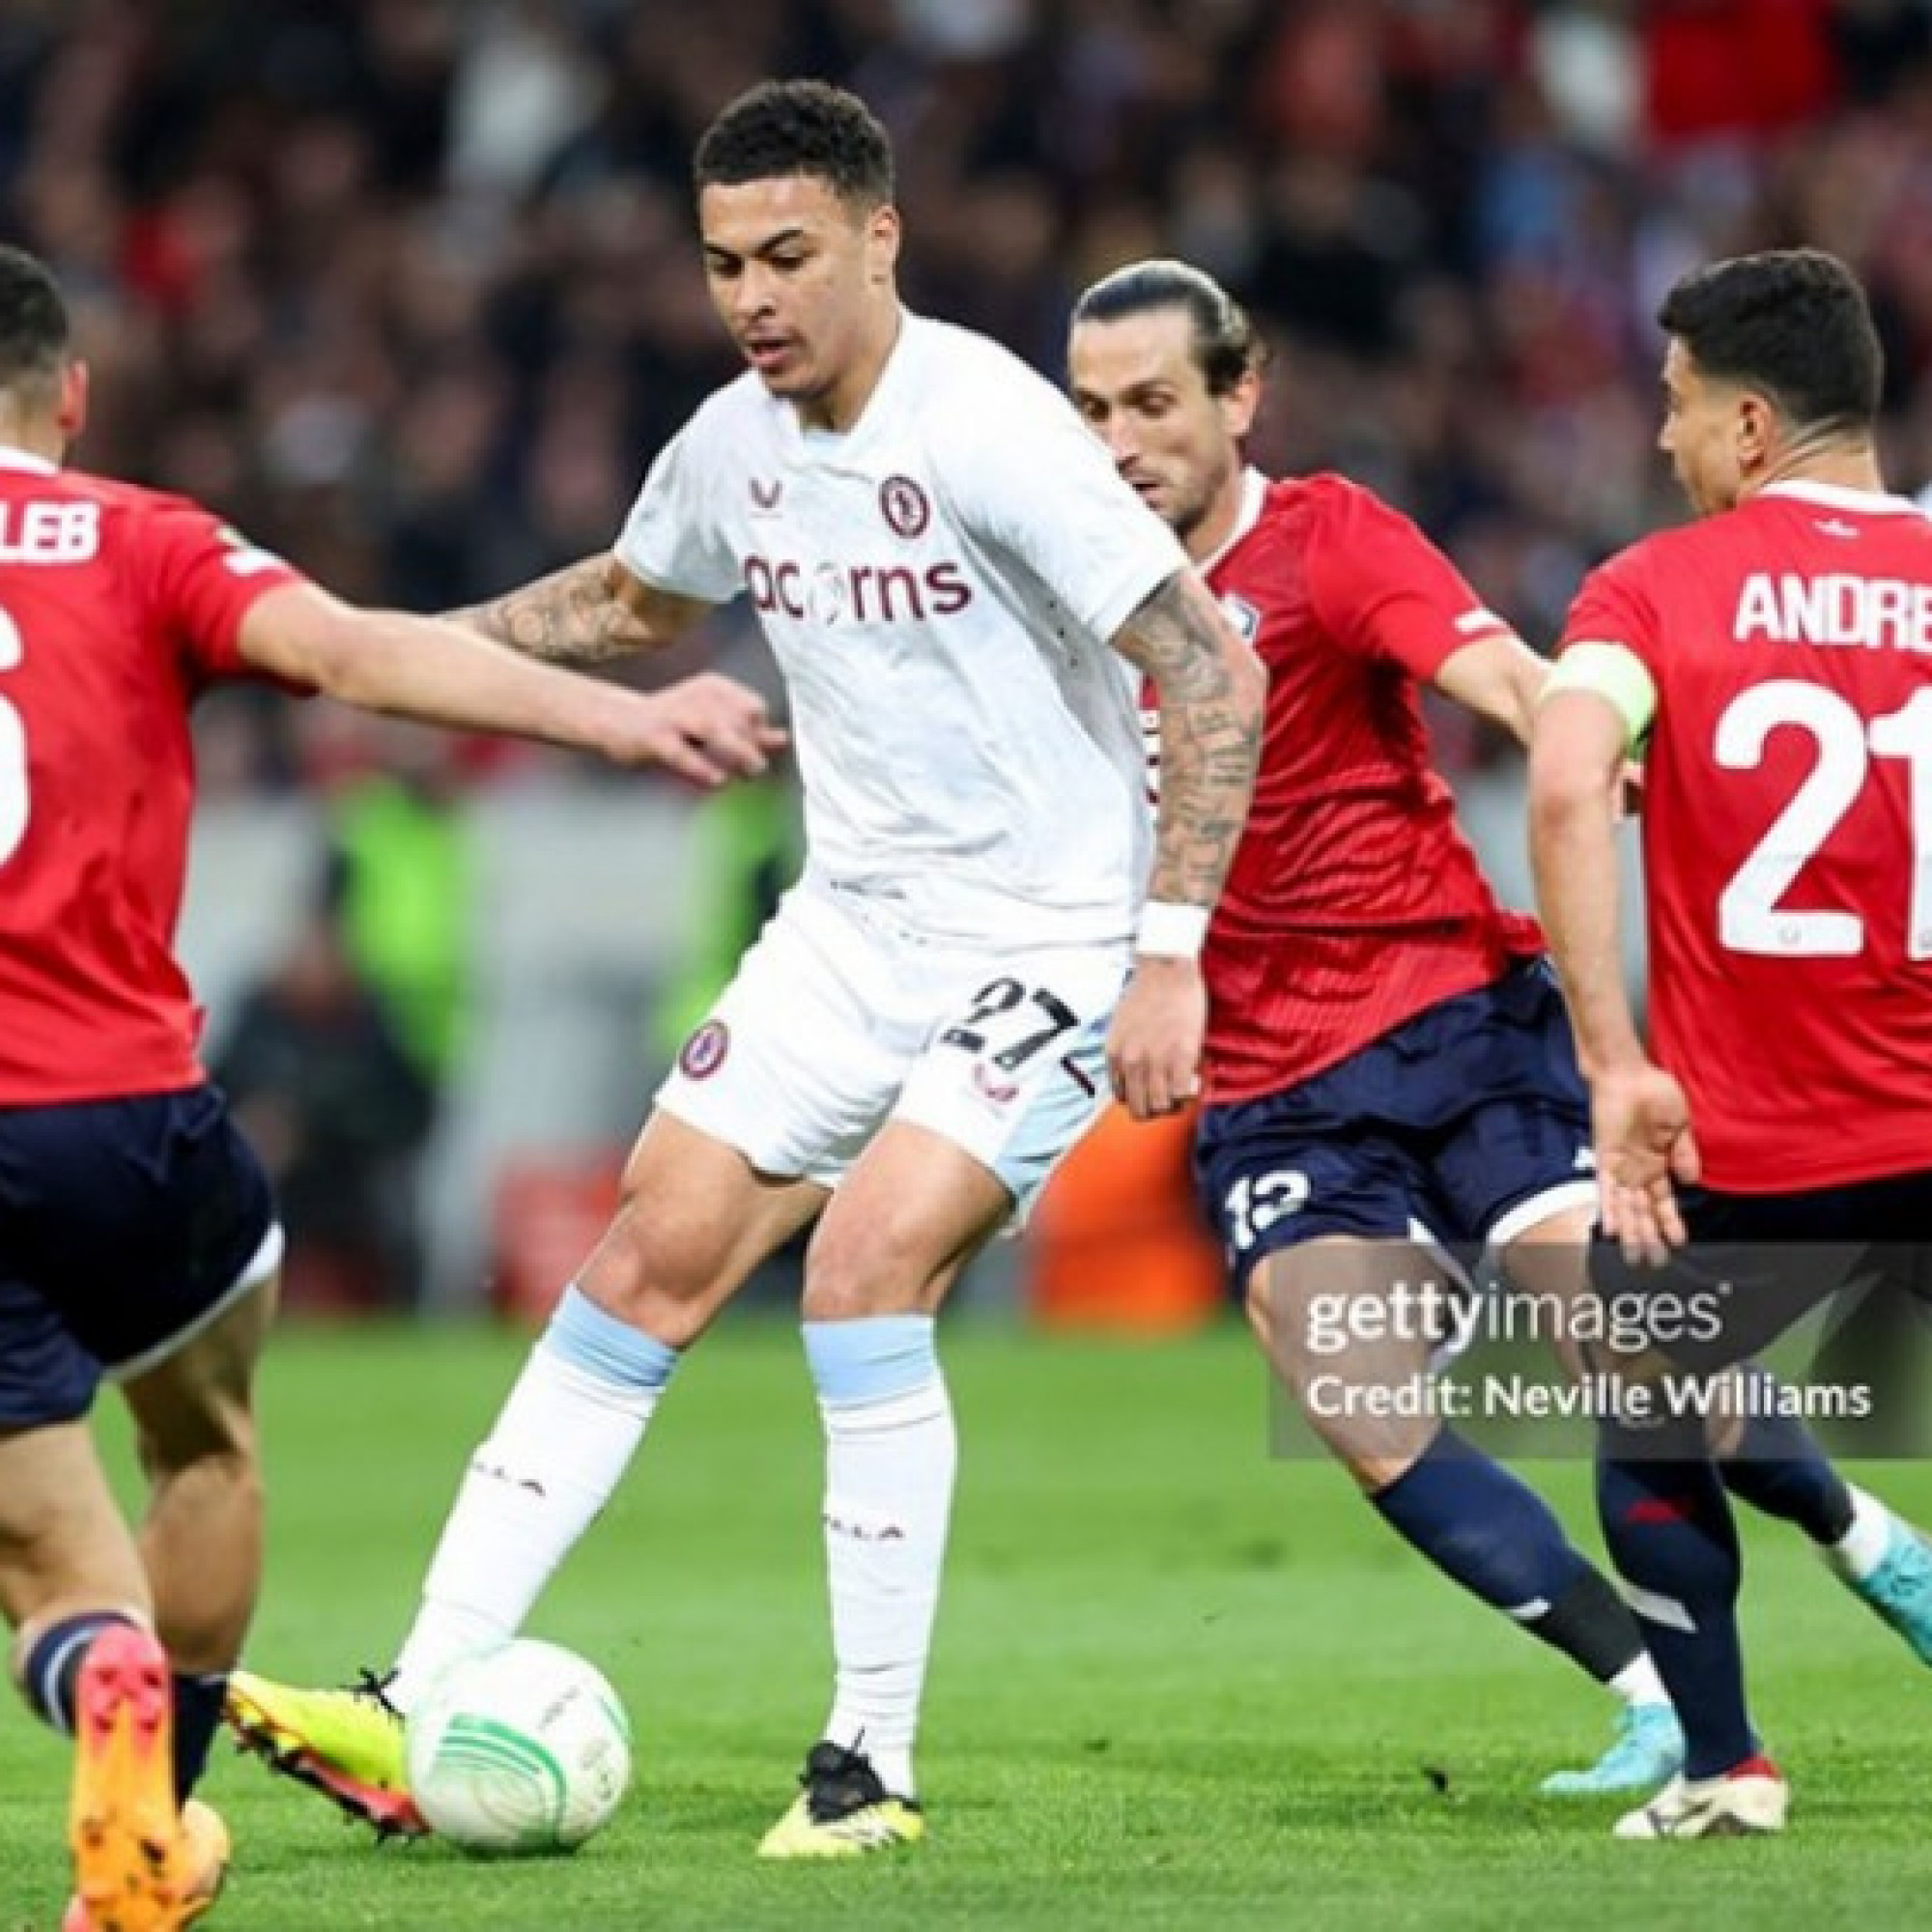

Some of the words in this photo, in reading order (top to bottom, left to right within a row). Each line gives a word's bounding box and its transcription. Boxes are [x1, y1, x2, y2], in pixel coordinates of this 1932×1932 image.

[1714, 678, 1932, 961] 21
[941, 977, 1079, 1070] 27
[1225, 1170, 1311, 1249] 12
